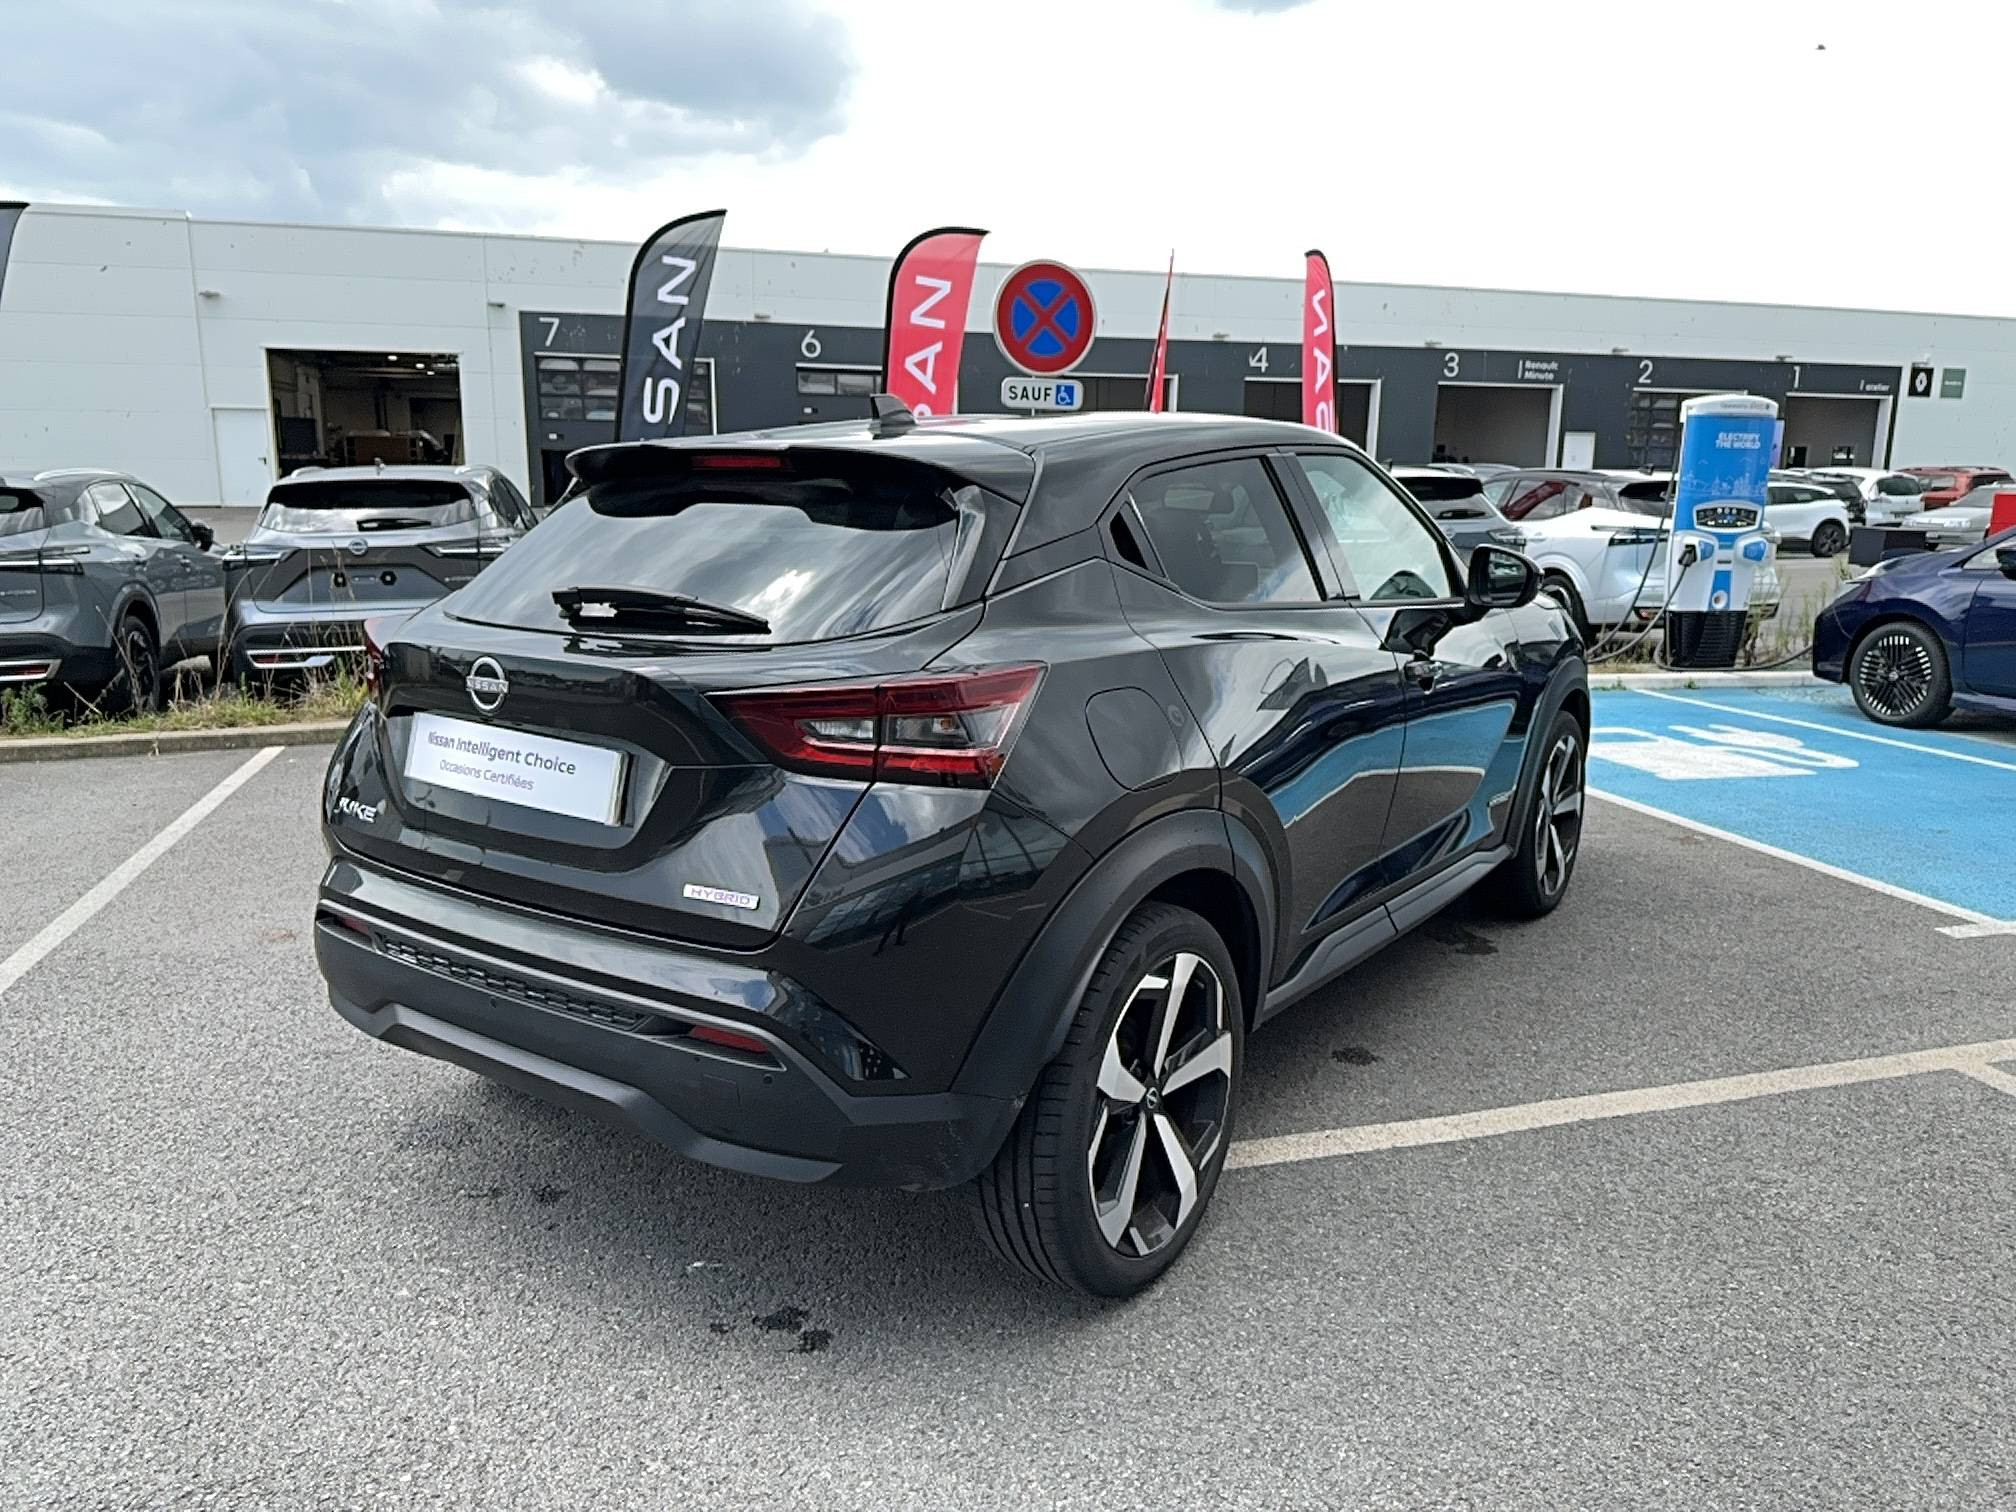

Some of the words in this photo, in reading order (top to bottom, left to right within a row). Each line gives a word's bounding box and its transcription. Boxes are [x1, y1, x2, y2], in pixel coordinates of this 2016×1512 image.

[539, 317, 560, 347] 7
[800, 329, 822, 358] 6
[1250, 347, 1269, 372] 4
[1443, 352, 1460, 378] 3
[1524, 359, 1558, 370] Renault
[1638, 360, 1654, 383] 2
[1523, 370, 1554, 380] Minute
[1793, 365, 1800, 389] 1
[1008, 385, 1053, 402] SAUF
[1715, 440, 1730, 449] THE
[1732, 440, 1761, 449] WORLD
[1718, 432, 1761, 442] ELECTRIFY
[427, 731, 456, 748] Nissan
[456, 736, 521, 764] Intelligent
[524, 752, 577, 775] Choice
[439, 759, 483, 779] Occasions
[484, 769, 535, 791] Certifiées
[333, 797, 377, 824] JUKE
[691, 887, 751, 905] HYBRID
